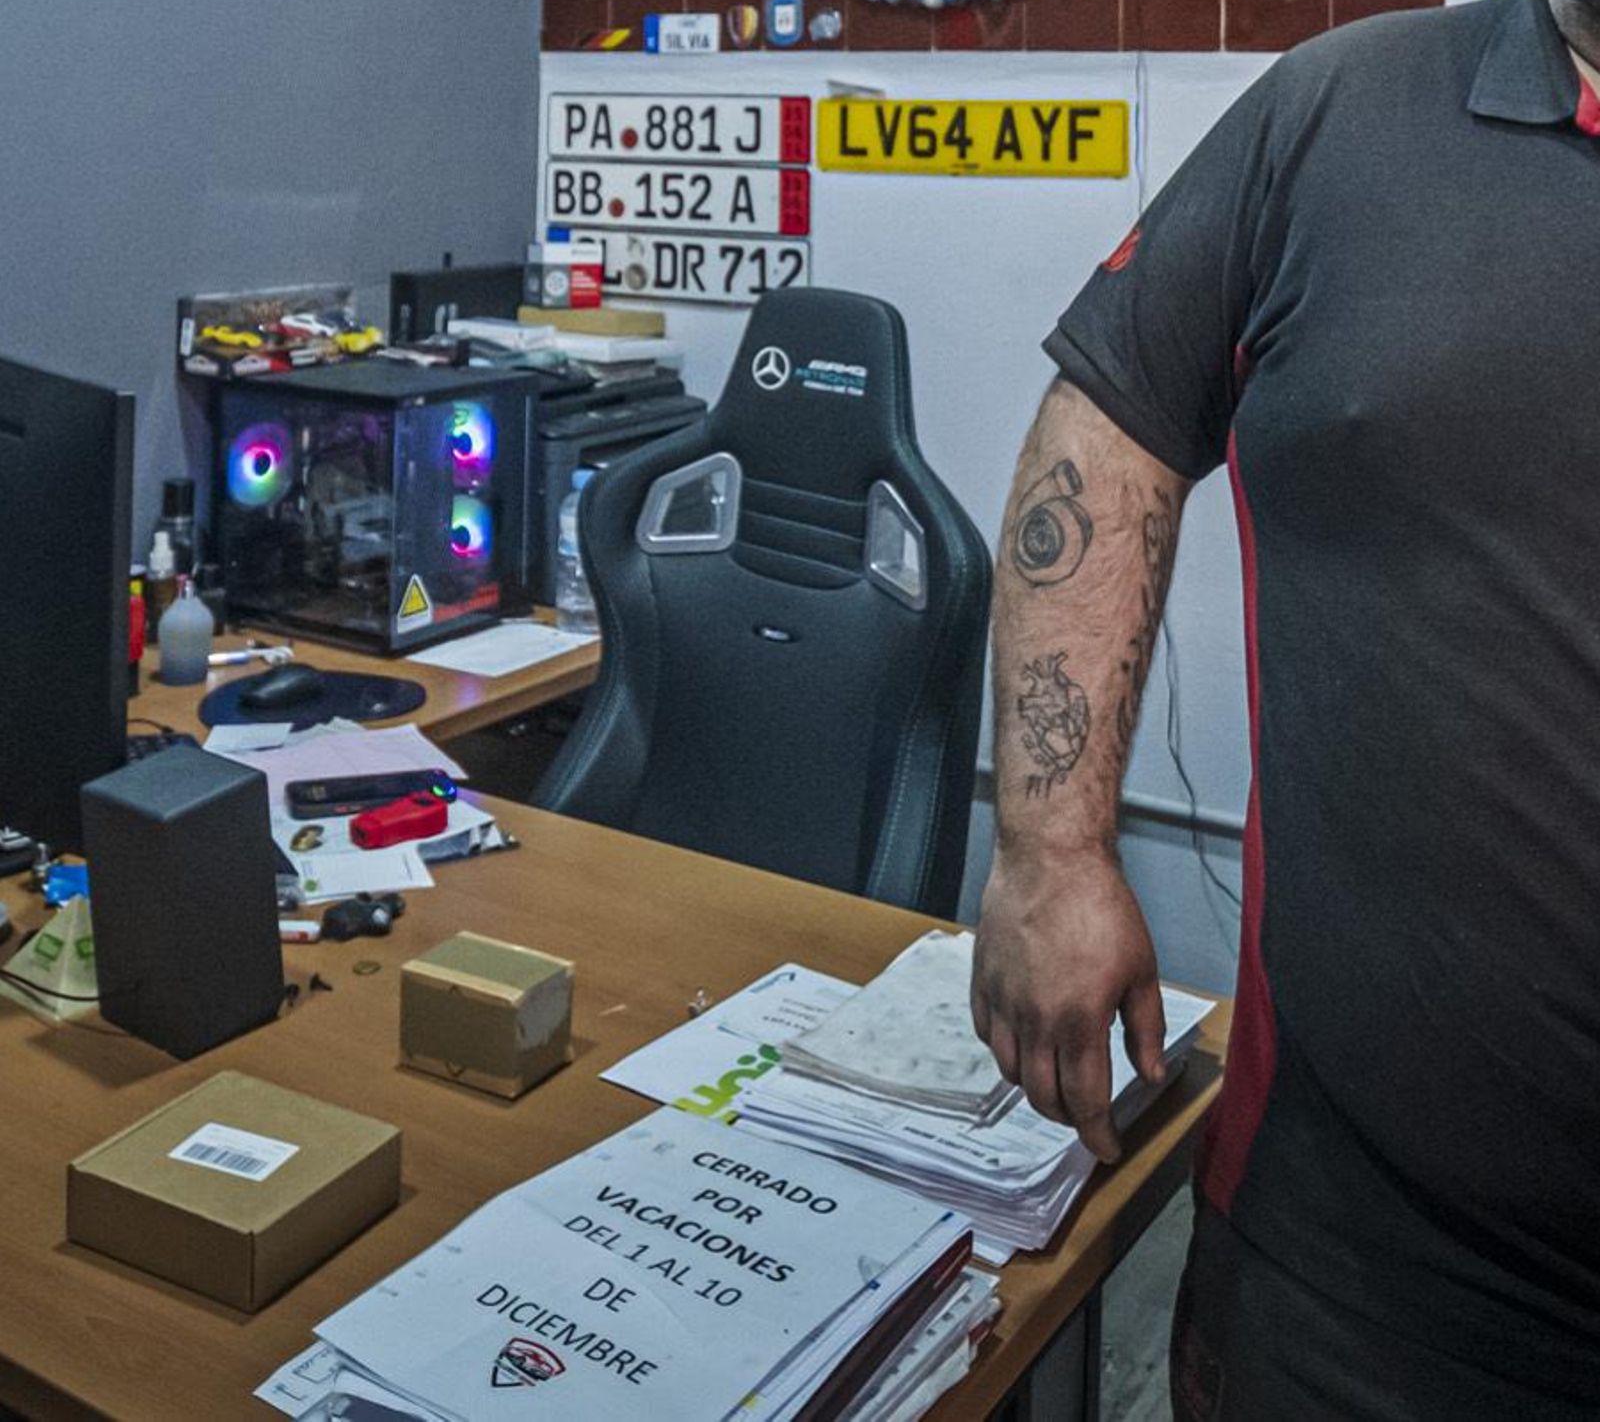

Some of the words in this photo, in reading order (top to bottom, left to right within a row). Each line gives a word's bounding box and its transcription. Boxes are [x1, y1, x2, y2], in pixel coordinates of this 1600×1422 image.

[565, 104, 613, 149] PA
[645, 105, 721, 152] 881
[735, 107, 762, 153] J
[839, 104, 973, 160] LV64
[994, 107, 1101, 162] AYF
[554, 170, 603, 216] BB
[635, 173, 712, 220] 152
[730, 176, 756, 224] A
[652, 242, 706, 292] DR
[719, 245, 803, 294] 712
[692, 1152, 838, 1214] CERRADO
[692, 1189, 763, 1225] POR
[564, 1215, 622, 1251] DEL
[624, 1243, 650, 1263] 1
[647, 1257, 692, 1287] AL
[694, 1279, 743, 1307] 10
[596, 1185, 795, 1282] VACACIONES
[582, 1277, 637, 1313] DE
[475, 1283, 659, 1385] DICIEMBRE
